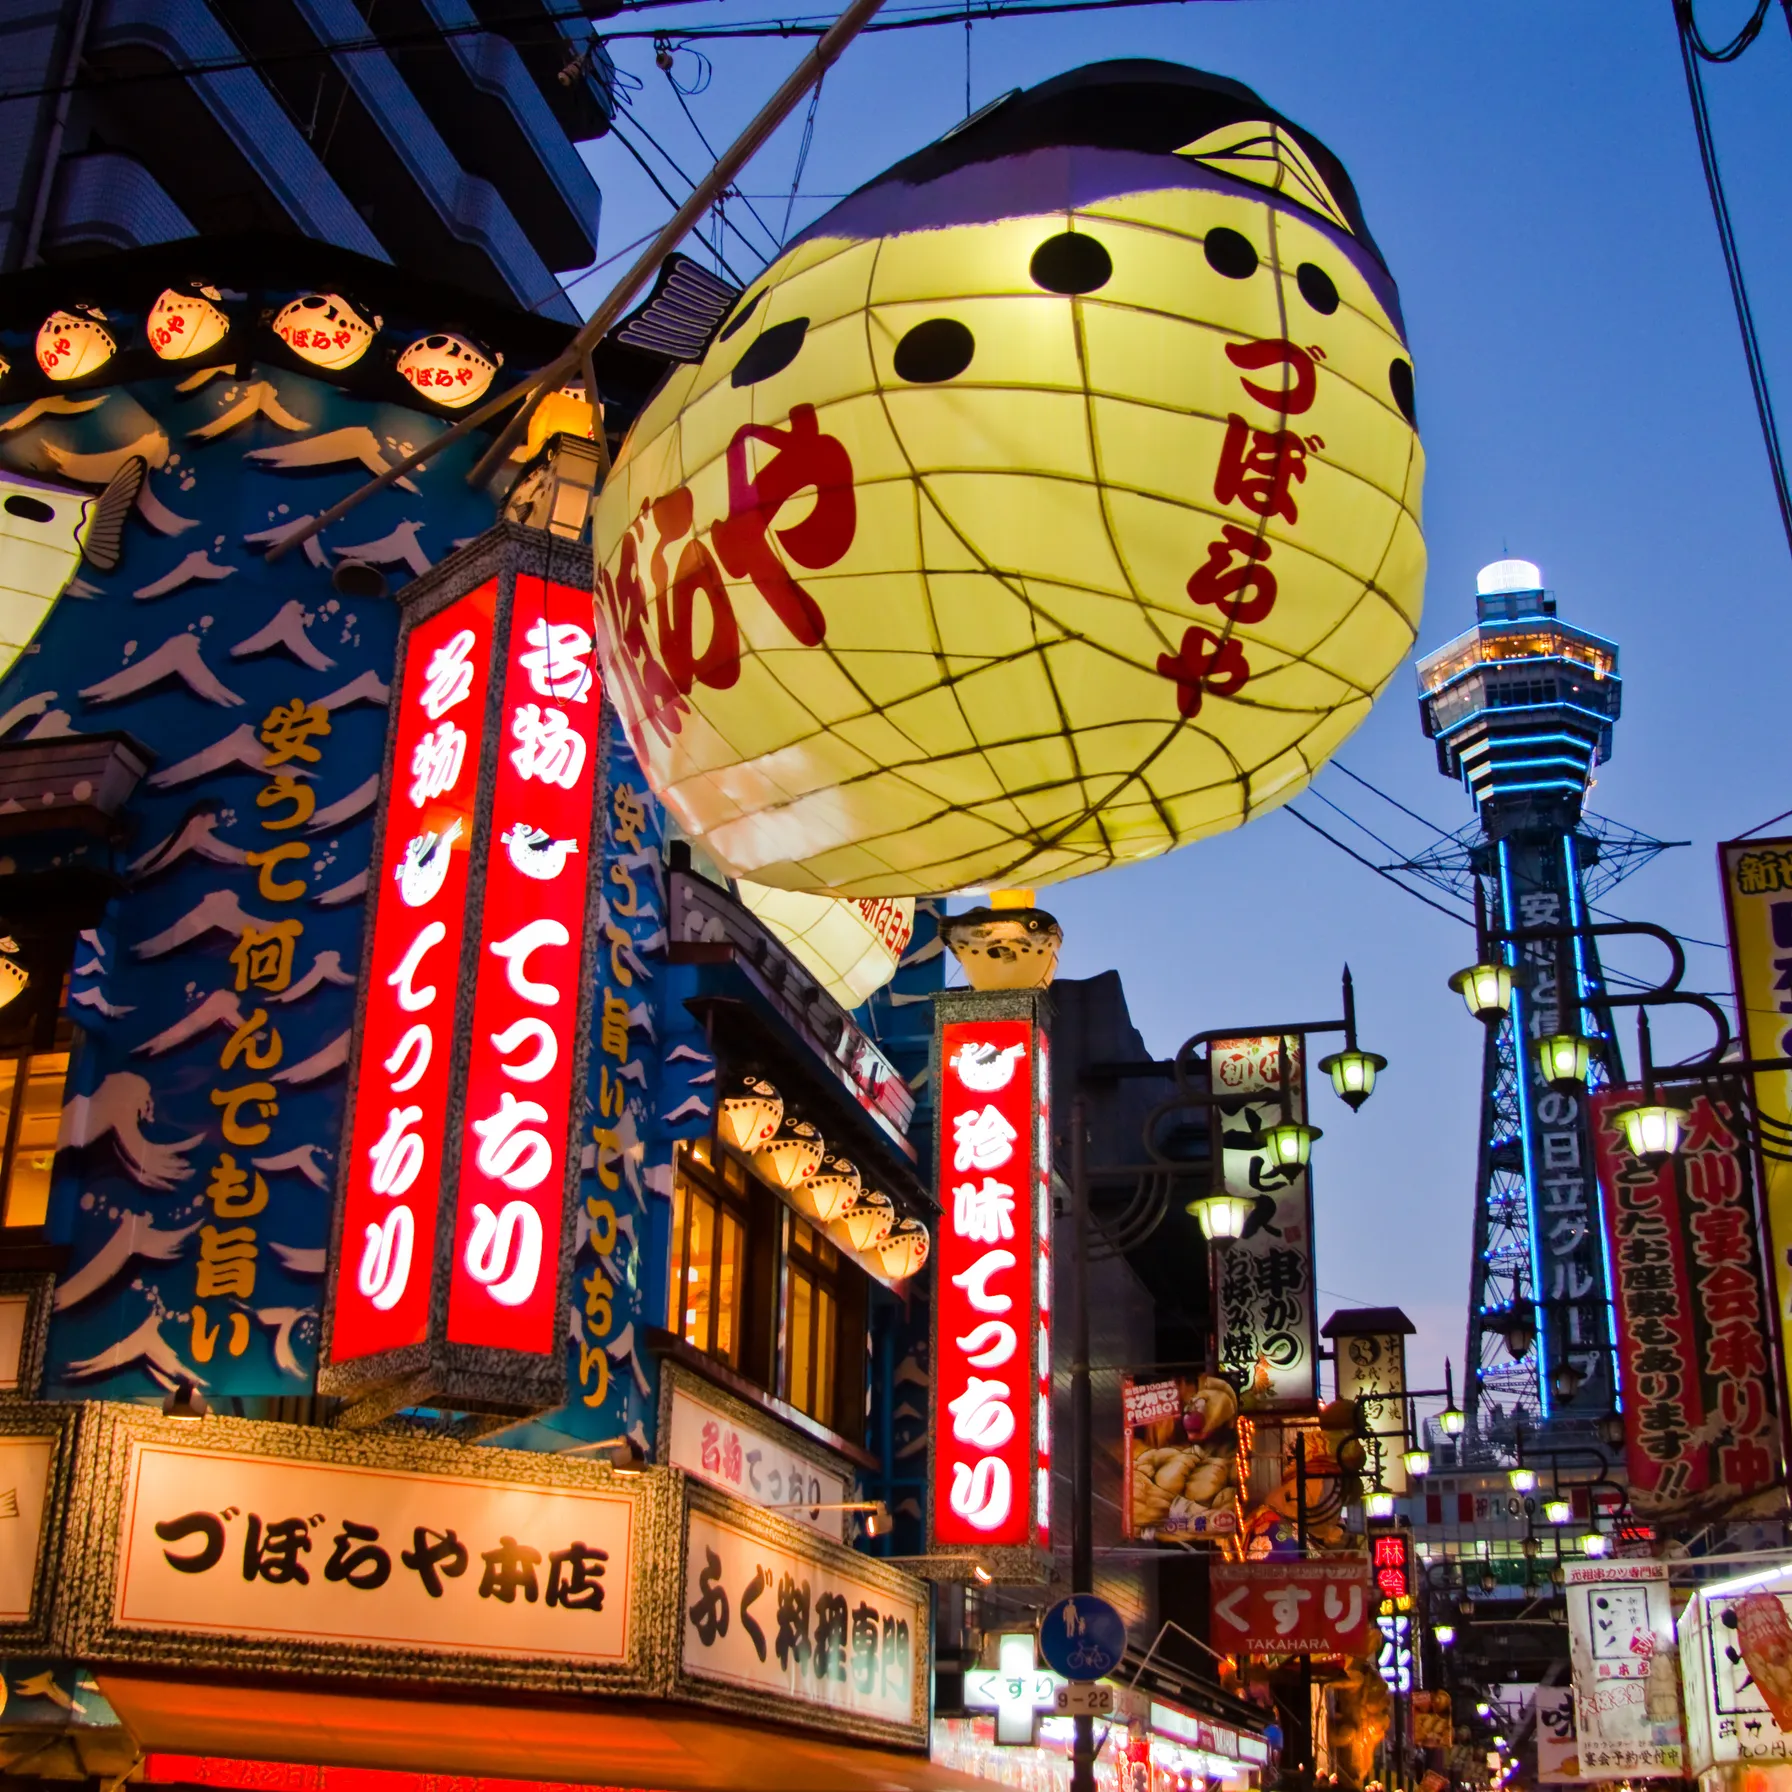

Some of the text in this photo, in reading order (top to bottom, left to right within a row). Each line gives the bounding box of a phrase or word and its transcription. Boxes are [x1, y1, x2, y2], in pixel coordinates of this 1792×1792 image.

[1157, 338, 1326, 718] づぼらや
[409, 629, 475, 808] 名物
[511, 617, 593, 790] 名物
[191, 699, 332, 1364] 安うて何んでも旨い
[948, 1104, 1017, 1531] 珍味てっちり
[1254, 1249, 1302, 1366] 串かつ
[1602, 1100, 1693, 1504] としたお座敷もあります!!
[1127, 1401, 1180, 1421] PROJECT
[155, 1506, 608, 1612] づぼらや本店
[1215, 1584, 1361, 1634] くすり
[1571, 1566, 1663, 1580] 元祖串カツ専門店
[690, 1545, 909, 1702] ふぐ料理専門
[1246, 1638, 1330, 1650] TAKAHARA
[979, 1676, 1054, 1700] くすり
[1585, 1748, 1679, 1767] 宴会予約受付中
